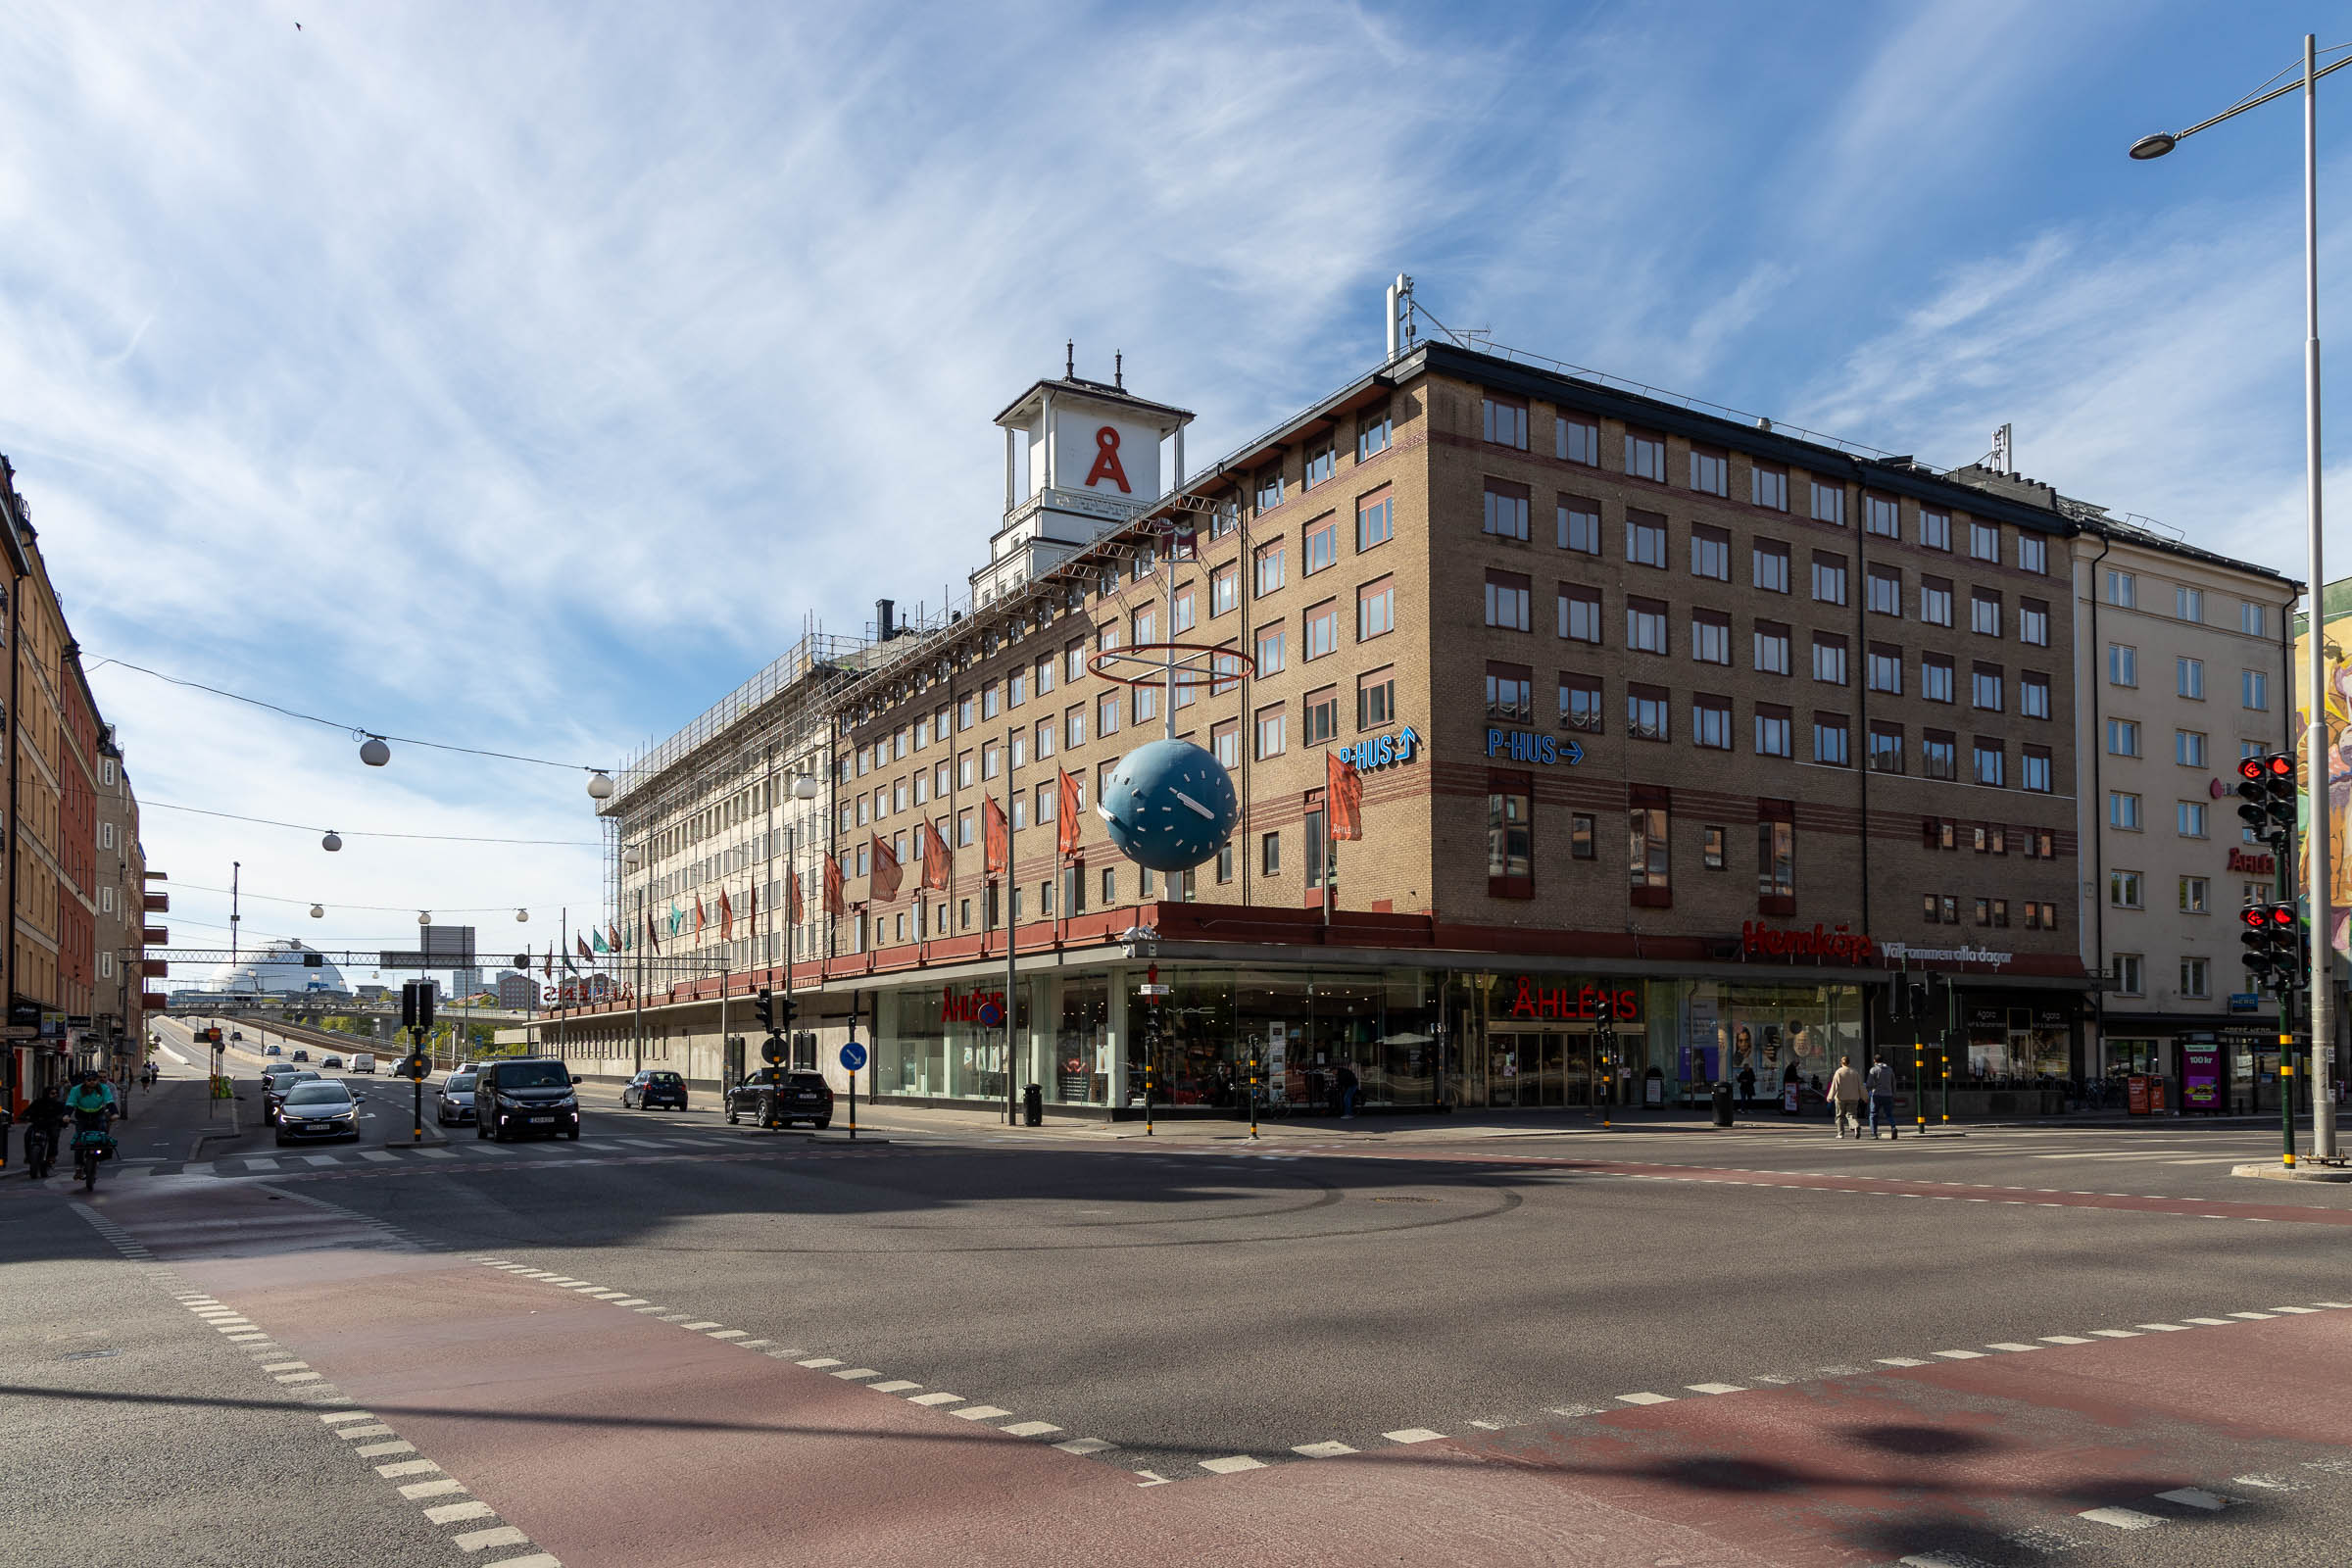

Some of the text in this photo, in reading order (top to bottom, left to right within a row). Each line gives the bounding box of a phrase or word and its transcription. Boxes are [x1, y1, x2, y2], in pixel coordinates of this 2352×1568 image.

[1084, 426, 1132, 494] Å
[1340, 734, 1393, 770] P-HUS
[1489, 728, 1556, 764] P-HUS
[1742, 920, 1873, 964] Hemköp
[1978, 947, 2013, 966] dagar
